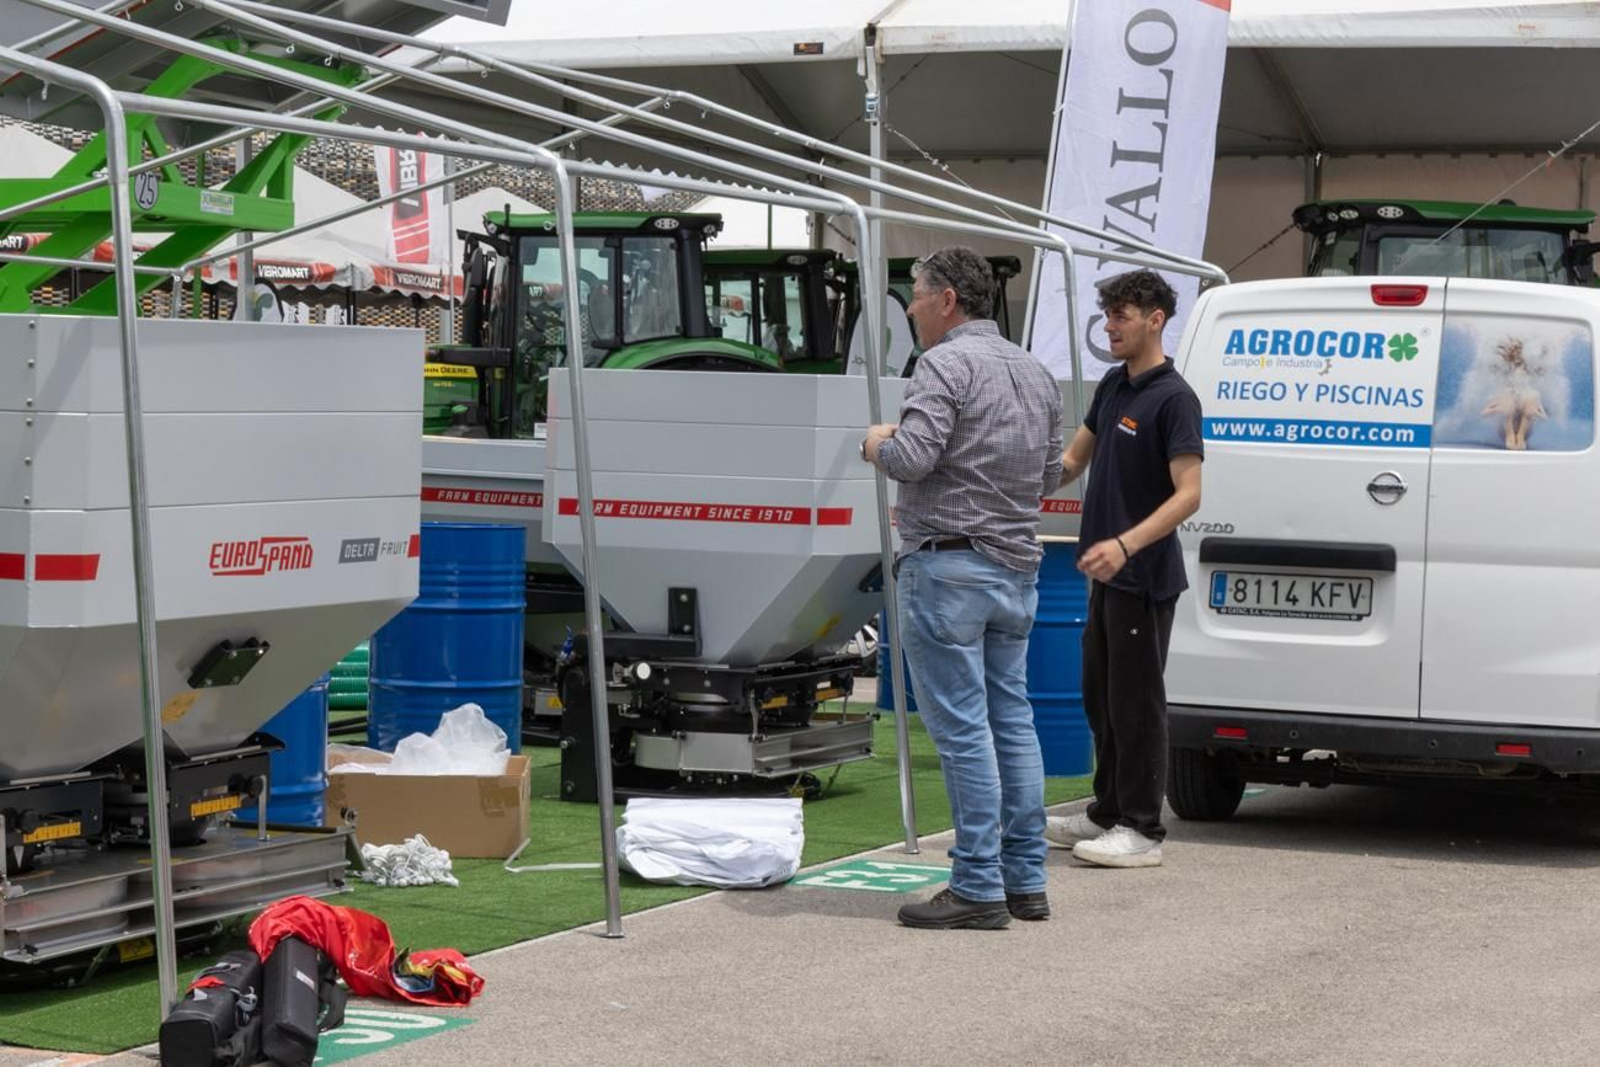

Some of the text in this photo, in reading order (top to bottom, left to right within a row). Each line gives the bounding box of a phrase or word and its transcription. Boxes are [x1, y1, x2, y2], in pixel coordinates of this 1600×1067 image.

[1085, 8, 1179, 364] CVALLO
[257, 265, 309, 279] VIBROMART
[1224, 329, 1386, 360] AGROCOR
[1222, 356, 1260, 369] Campo
[1217, 380, 1424, 408] RIEGO Y PISCINAS
[1211, 421, 1415, 443] www.agrocor.com
[438, 489, 544, 507] FARM EQUIPMENT
[619, 502, 702, 519] EQUIPMENT
[708, 506, 752, 521] SINCE
[758, 509, 794, 522] 1970
[1180, 521, 1235, 535] NV200
[209, 536, 408, 576] EUROSPAND DELTA FRUIT
[1233, 578, 1363, 610] 8114 KFV
